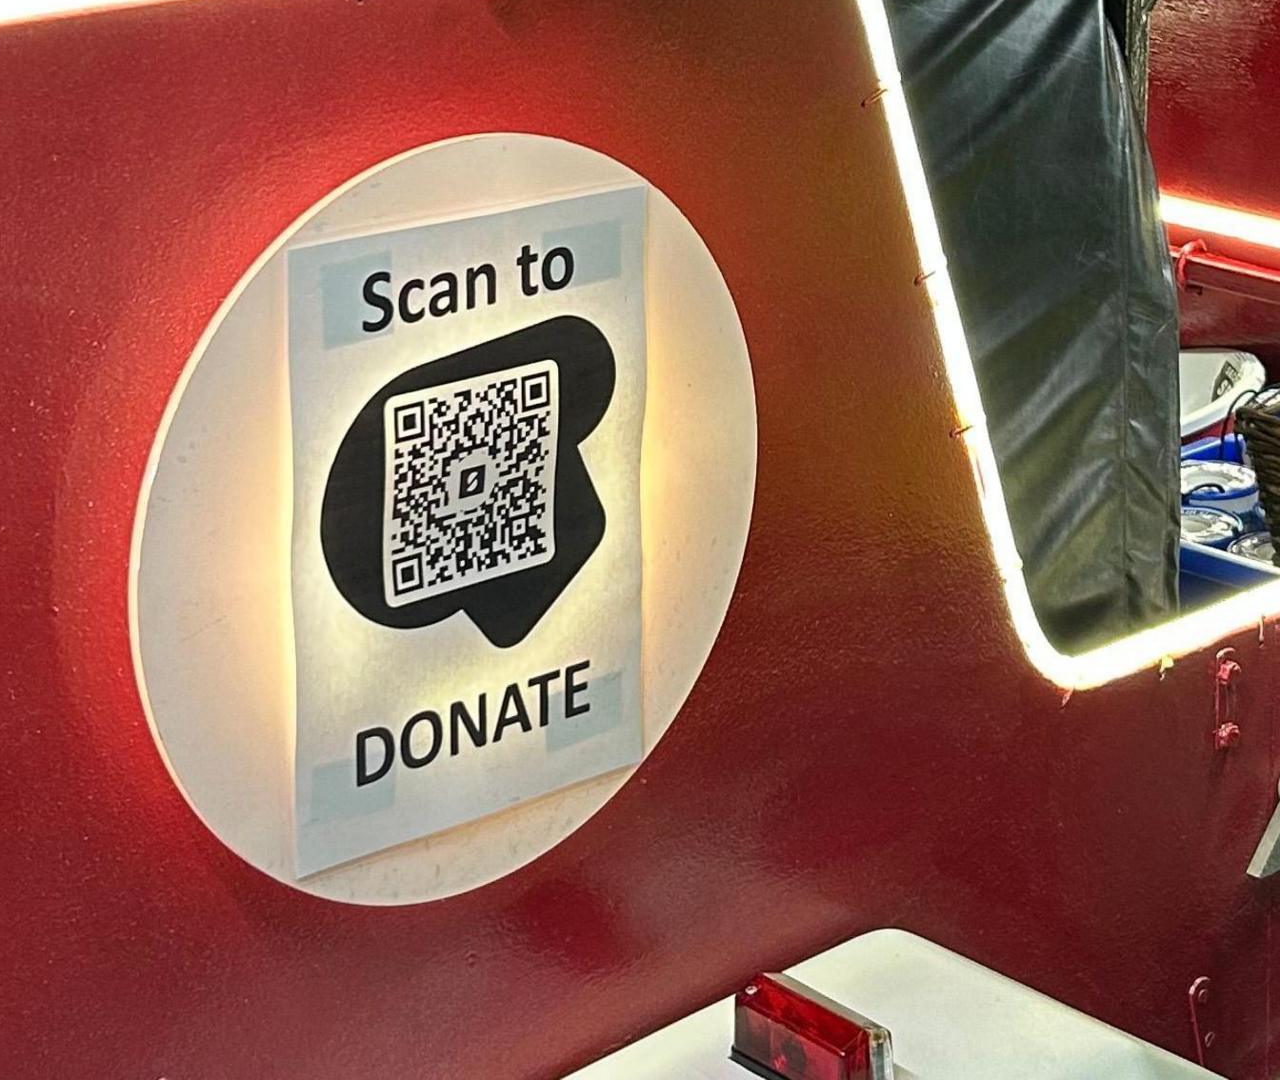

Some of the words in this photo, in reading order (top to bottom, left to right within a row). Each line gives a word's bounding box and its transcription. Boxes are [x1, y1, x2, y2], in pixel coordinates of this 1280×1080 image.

[360, 260, 497, 333] Scan
[517, 244, 575, 296] to
[354, 660, 592, 788] DONATE
